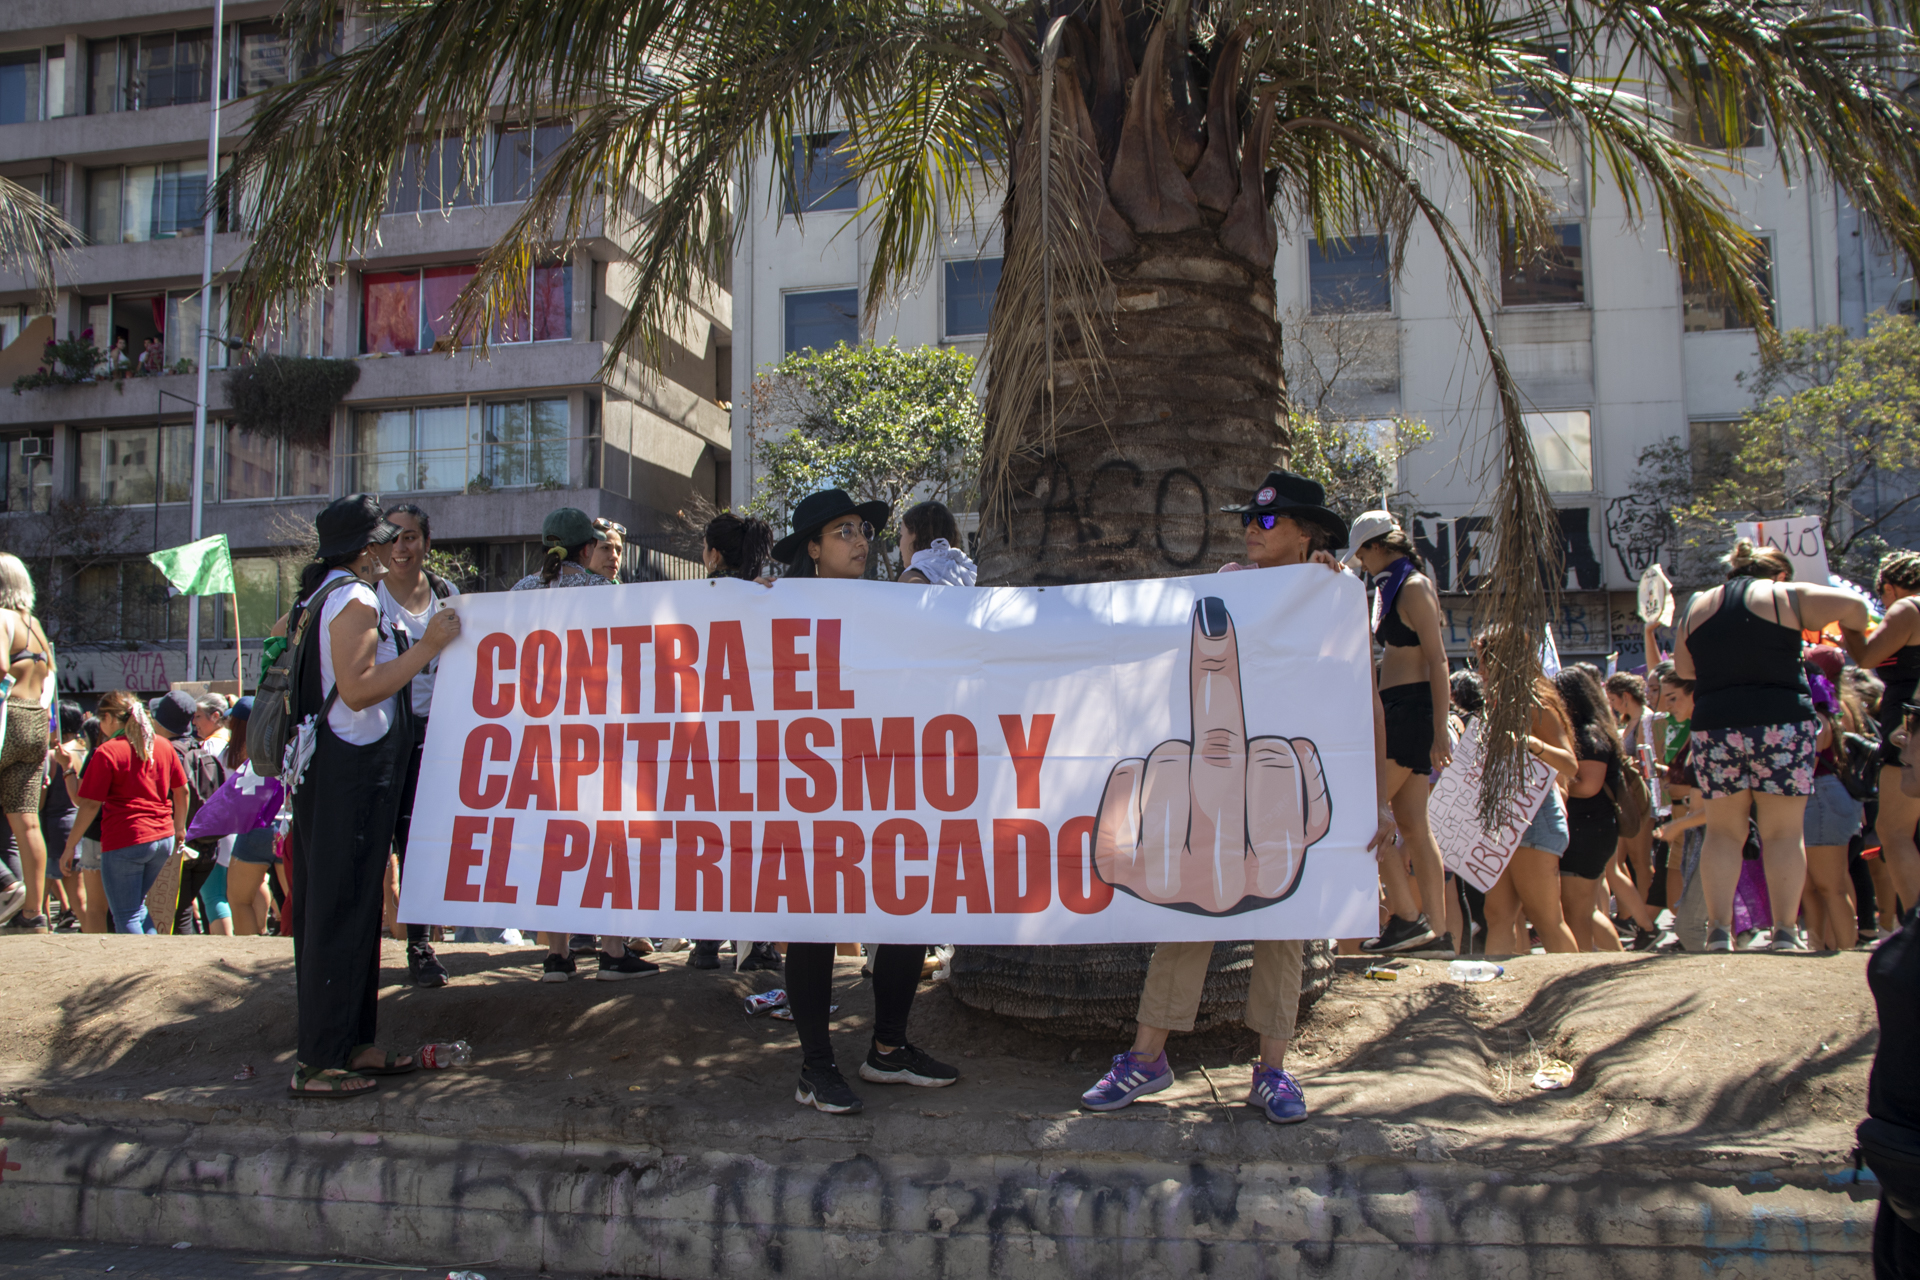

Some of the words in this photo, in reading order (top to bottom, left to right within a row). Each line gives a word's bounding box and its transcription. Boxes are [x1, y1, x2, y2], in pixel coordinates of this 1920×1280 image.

[120, 651, 166, 676] YUTA
[473, 620, 755, 718] CONTRA
[772, 618, 855, 711] EL
[459, 713, 979, 813] CAPITALISMO
[999, 713, 1056, 809] Y
[1427, 776, 1459, 834] UIERO
[443, 815, 518, 904] EL
[536, 816, 1114, 915] PATRIARCADO
